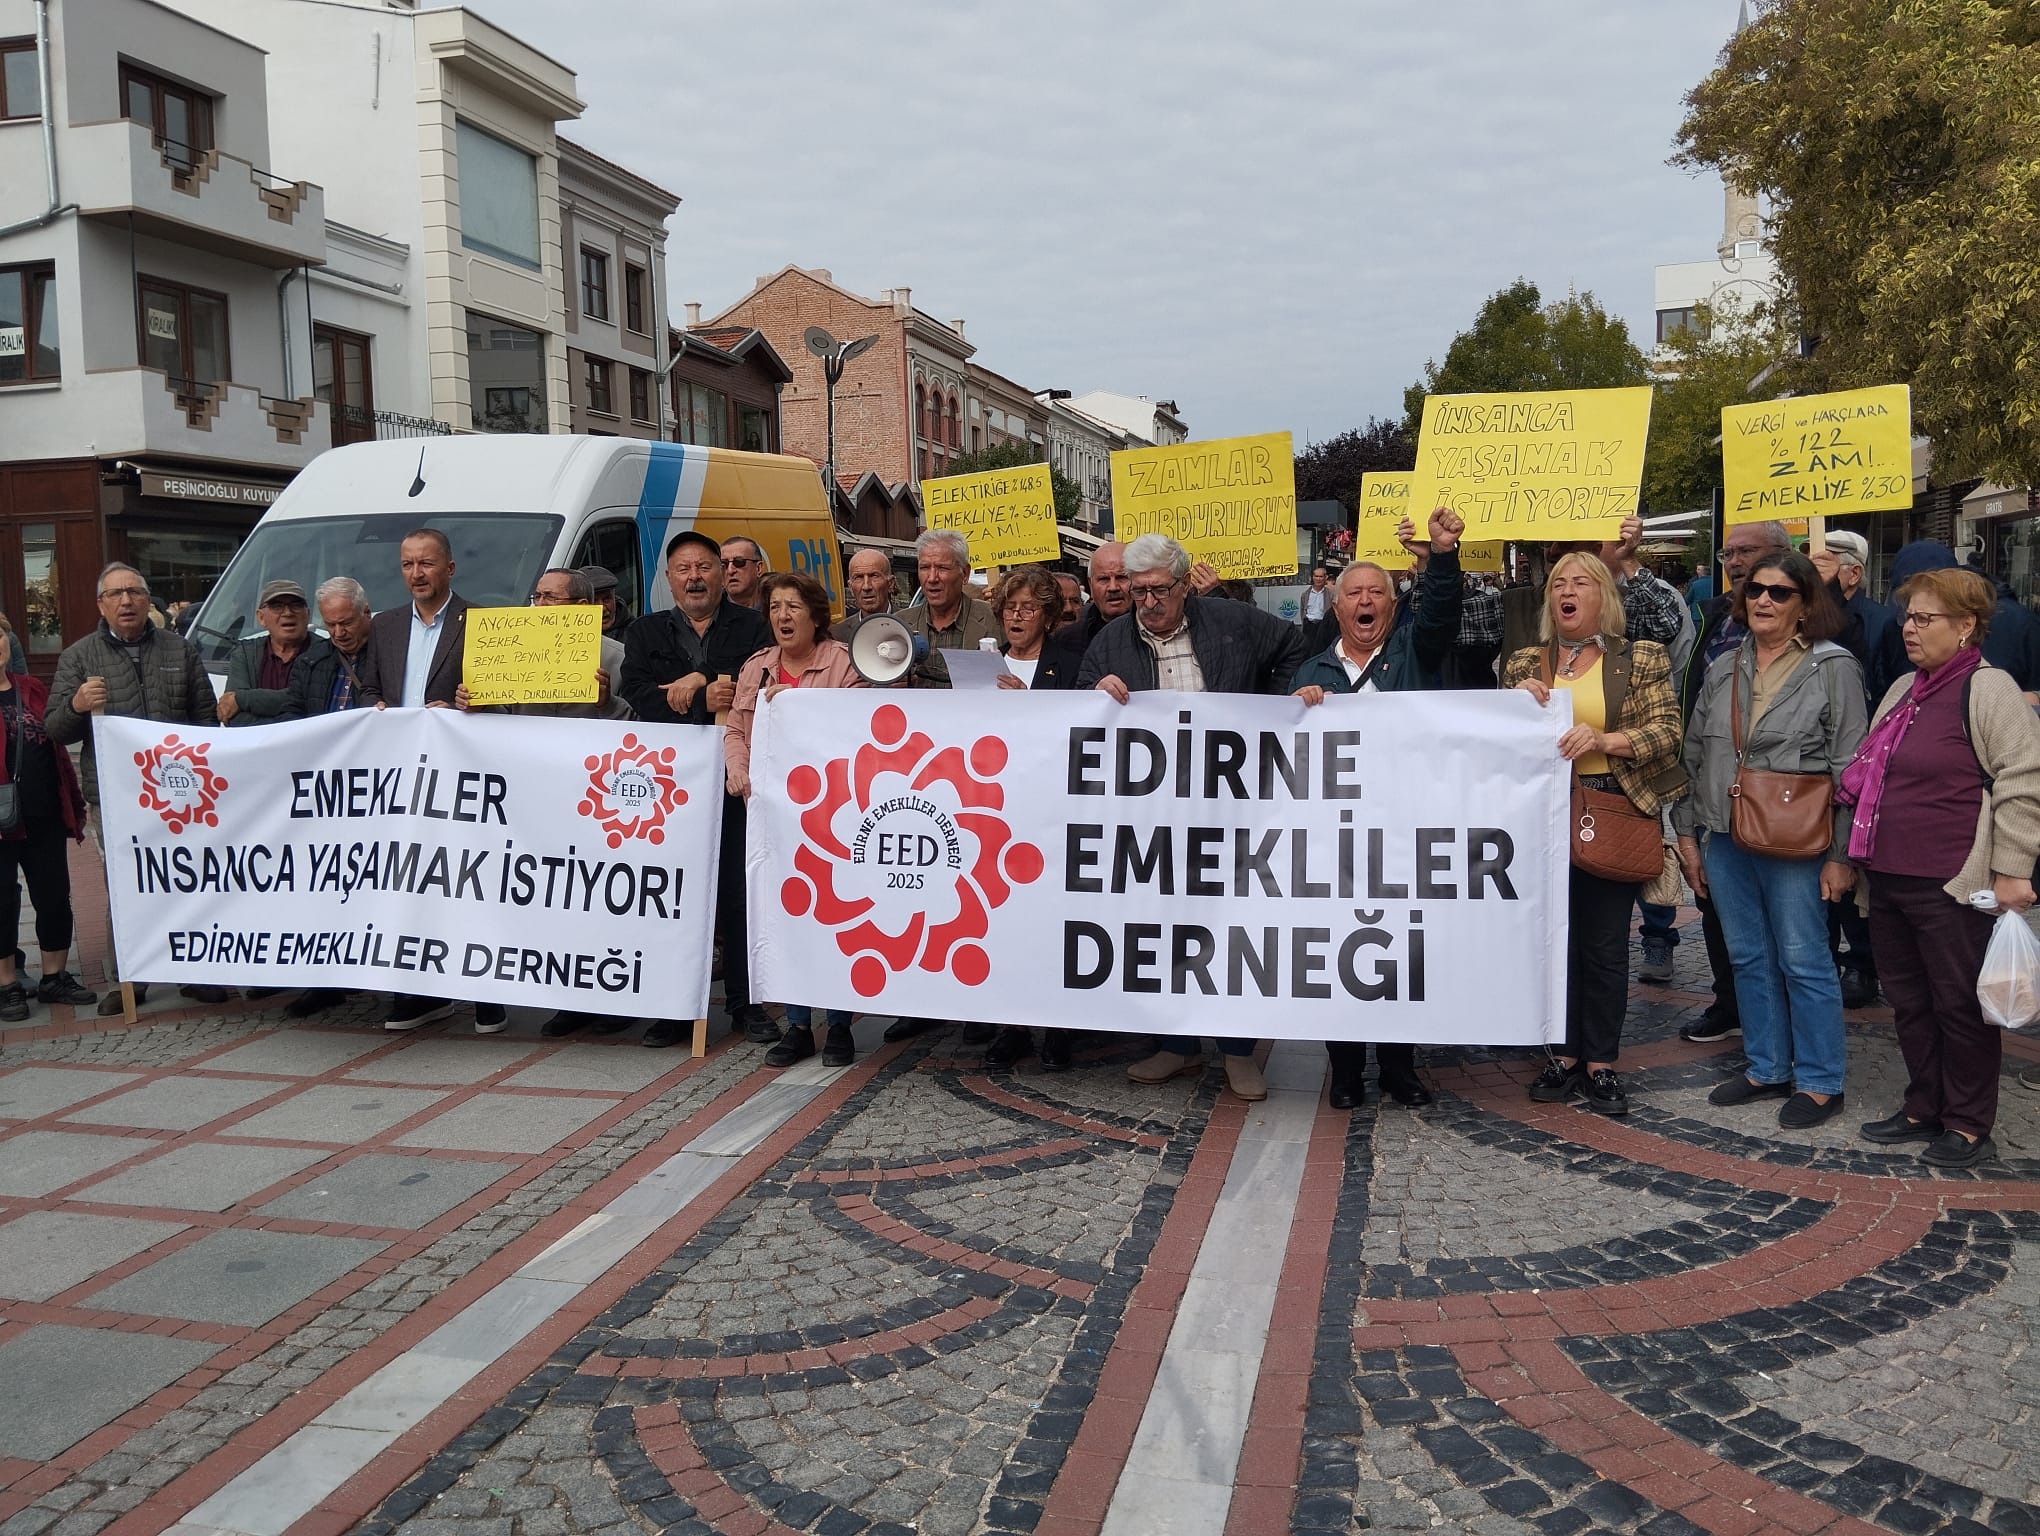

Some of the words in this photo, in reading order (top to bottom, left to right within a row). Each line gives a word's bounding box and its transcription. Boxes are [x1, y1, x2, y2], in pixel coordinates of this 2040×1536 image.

[1433, 401, 1574, 435] İNSANCA
[1736, 404, 1786, 436] VERGİ
[1812, 403, 1889, 426] HARÇLARA
[1129, 446, 1273, 497] ZAMLAR
[1431, 440, 1622, 484] YAŞAMAK
[163, 479, 238, 498] PEŞİNCİOĞLU
[1736, 475, 1854, 511] EMEKLİYE
[932, 503, 1005, 531] EMEKLİYE
[478, 613, 535, 632] AYÇİÇEK
[538, 613, 559, 626] YAĞI
[470, 654, 508, 667] BEYAZ
[514, 649, 550, 665] PEYNİR
[472, 669, 536, 684] EMEKLİYE
[469, 690, 516, 701] ZAMLAR
[1067, 710, 1363, 801] EDİRNE
[168, 776, 190, 788] EED
[290, 753, 508, 825] EMEKLİLER
[621, 783, 647, 798] EED
[853, 817, 876, 864] EDİRNE
[871, 795, 937, 821] EMEKLİLER
[877, 833, 939, 866] EED
[1065, 809, 1519, 900] EMEKLİLER
[132, 835, 295, 893] İNSANCA
[307, 840, 490, 904] YAŞAMAK
[500, 839, 684, 920] İSTİYOR!
[887, 872, 925, 890] 2025
[168, 922, 271, 964] EDİRNE
[276, 922, 449, 975] EMEKLİLER
[461, 943, 643, 994] DERNEĞİ
[1063, 908, 1425, 1002] DERNEĞİ
